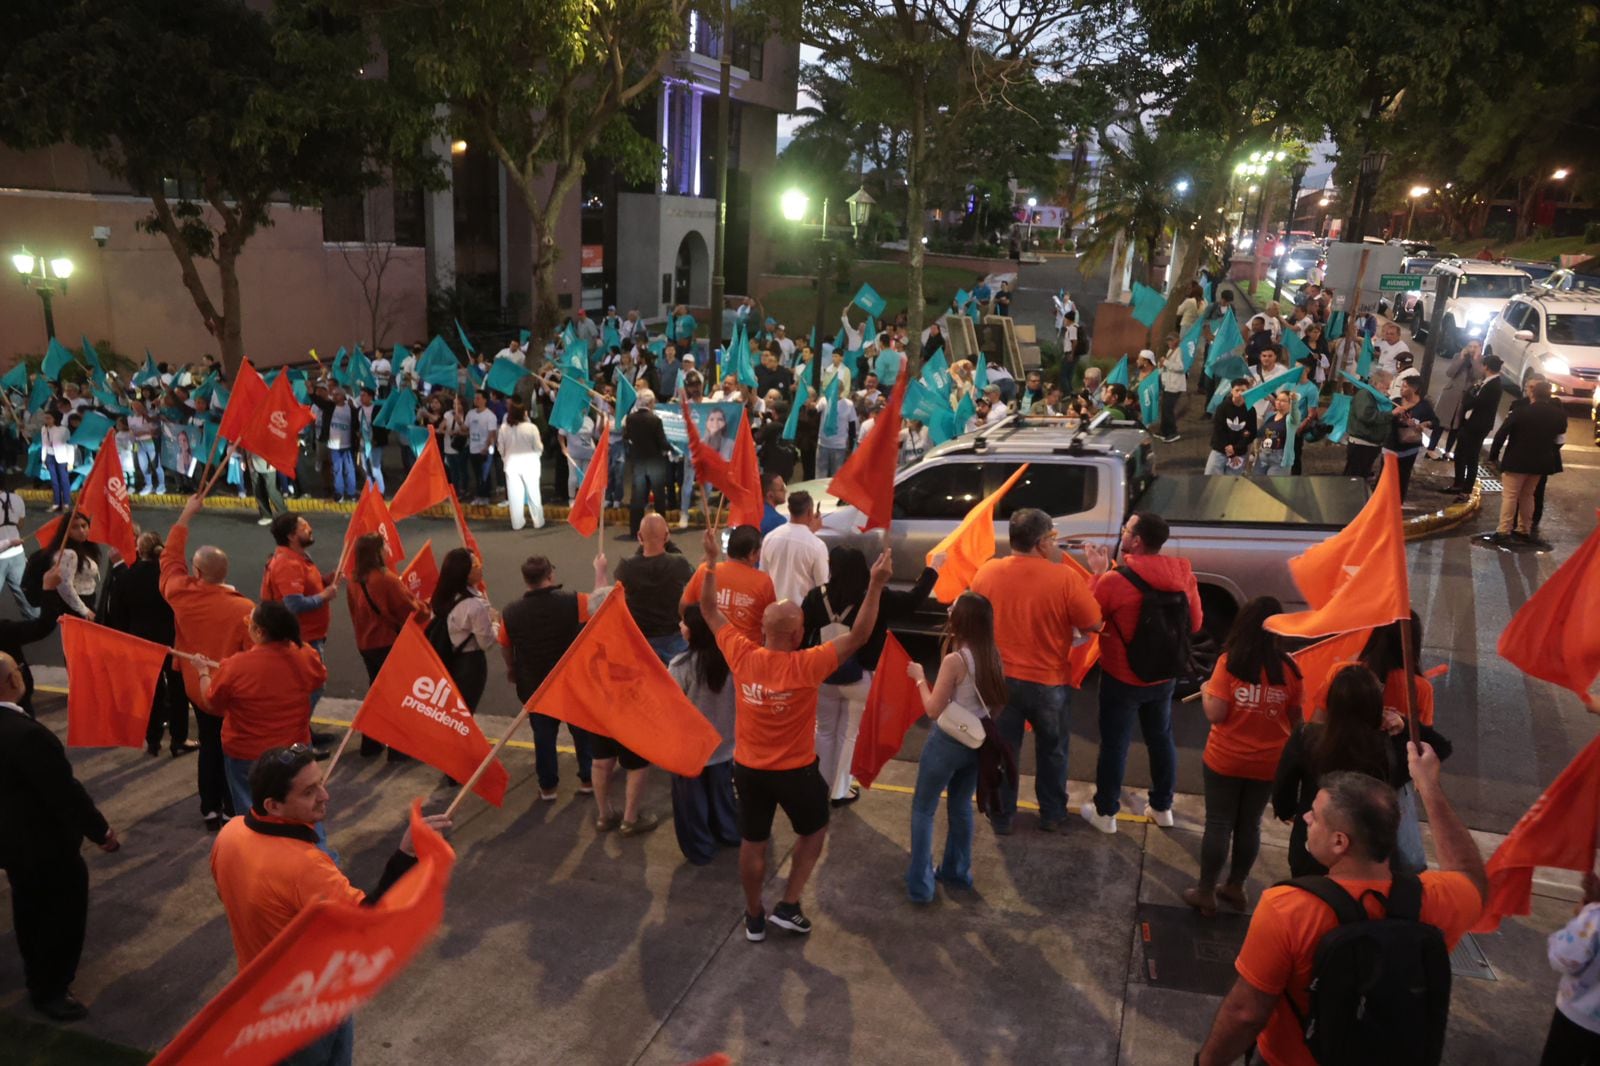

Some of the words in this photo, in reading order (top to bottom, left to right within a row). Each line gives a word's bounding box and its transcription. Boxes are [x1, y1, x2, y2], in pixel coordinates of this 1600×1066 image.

[412, 676, 452, 708] eli
[1234, 684, 1262, 703] eli
[400, 695, 470, 736] presidente
